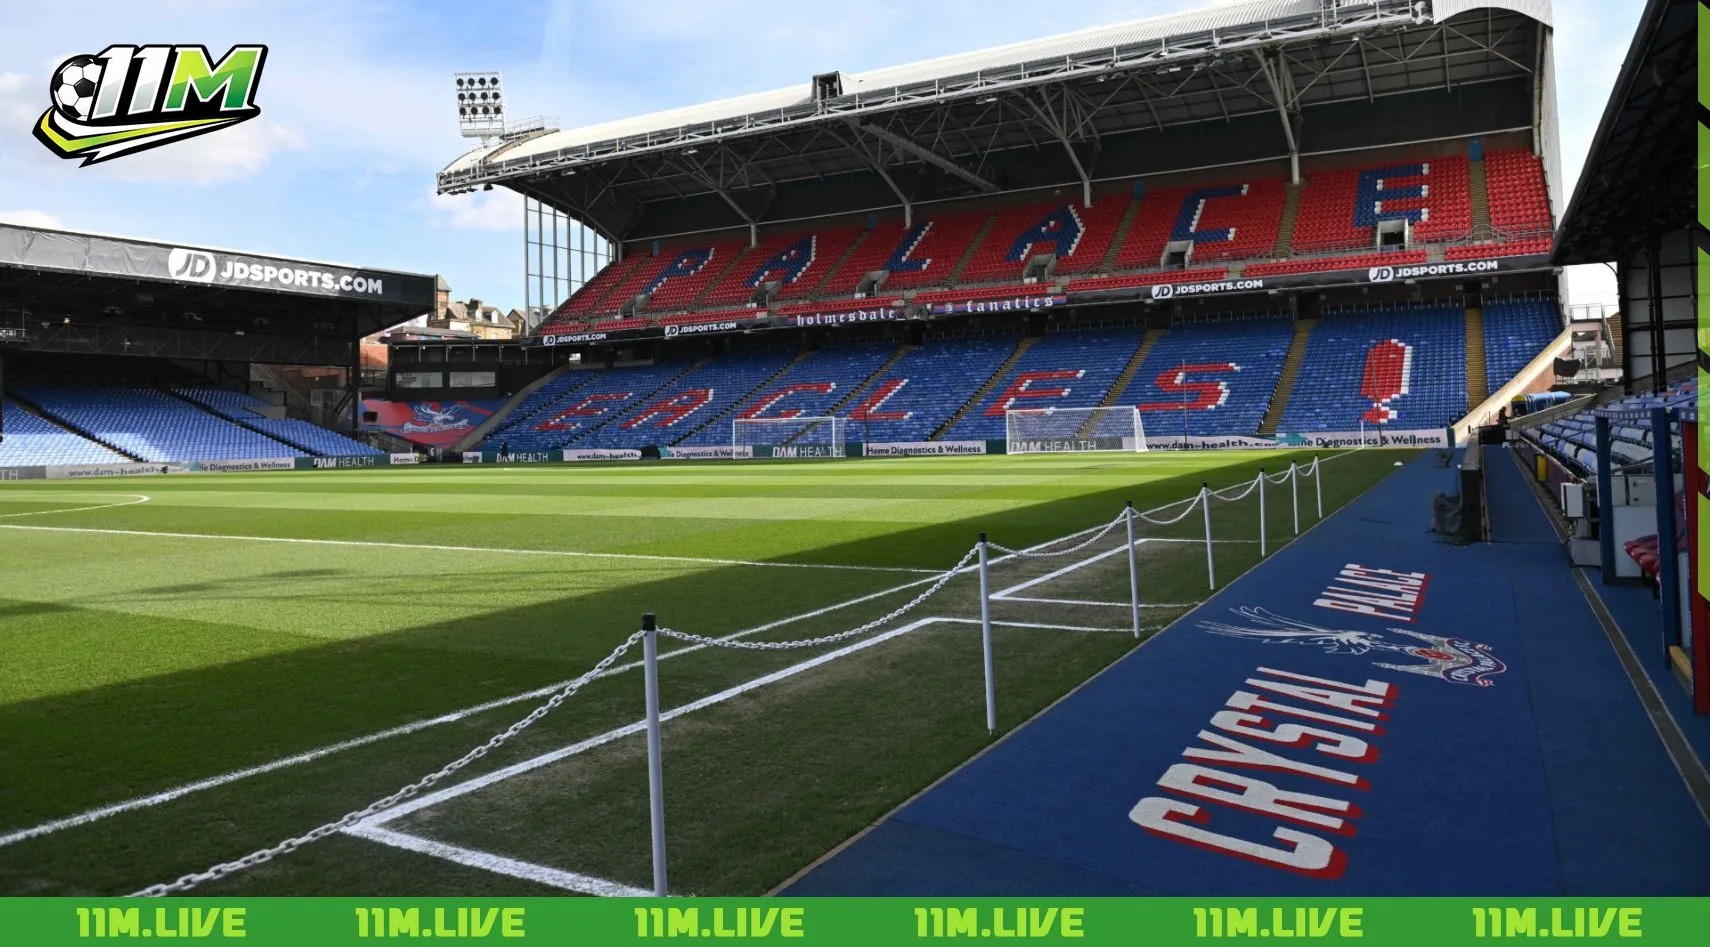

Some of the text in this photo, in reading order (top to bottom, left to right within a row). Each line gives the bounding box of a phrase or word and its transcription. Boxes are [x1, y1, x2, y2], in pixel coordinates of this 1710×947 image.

[640, 163, 1429, 295] PALACE
[173, 251, 383, 295] JD JDSPORTS.COM
[1395, 261, 1498, 277] JDSPORTS.COM
[1175, 280, 1263, 295] JDSPORTS.COM
[796, 296, 1055, 326] holmesdale fanatics
[680, 322, 737, 333] JDSPORTS.COM
[556, 333, 607, 343] JDSPORTS.COM
[1391, 434, 1441, 445] Wellness
[867, 445, 982, 456] Home Diagnostics & Wellness
[1045, 440, 1097, 451] HEALTH
[516, 452, 549, 463] HEALTH
[676, 450, 713, 459] Diagnostics
[772, 446, 798, 458] DAM
[210, 463, 252, 472] Diagnostics
[260, 461, 291, 469] Wellness
[338, 456, 375, 467] HEALTH
[1128, 563, 1430, 877] CRYSTAL PALACE
